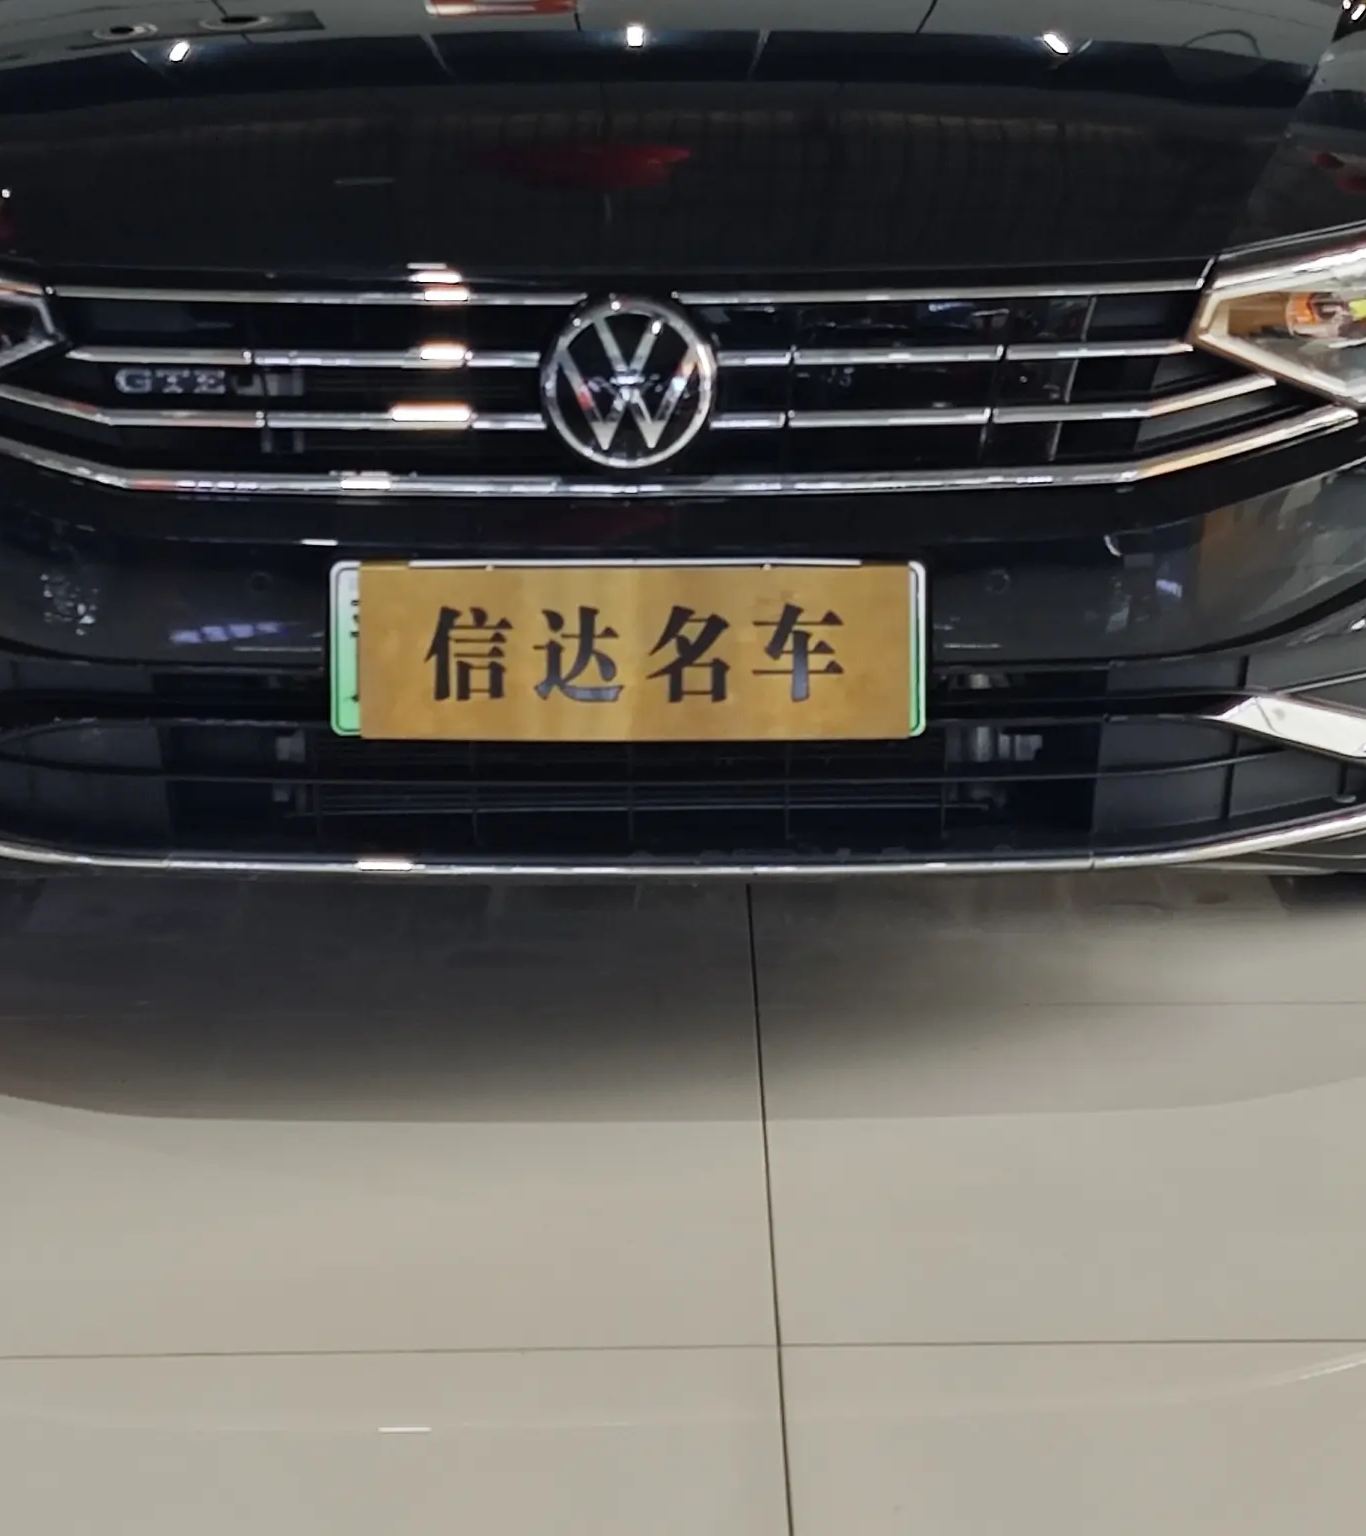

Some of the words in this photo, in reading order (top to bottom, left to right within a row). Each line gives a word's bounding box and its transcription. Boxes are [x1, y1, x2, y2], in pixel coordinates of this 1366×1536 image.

[114, 368, 227, 395] GTE
[423, 603, 845, 703] 信达名车
